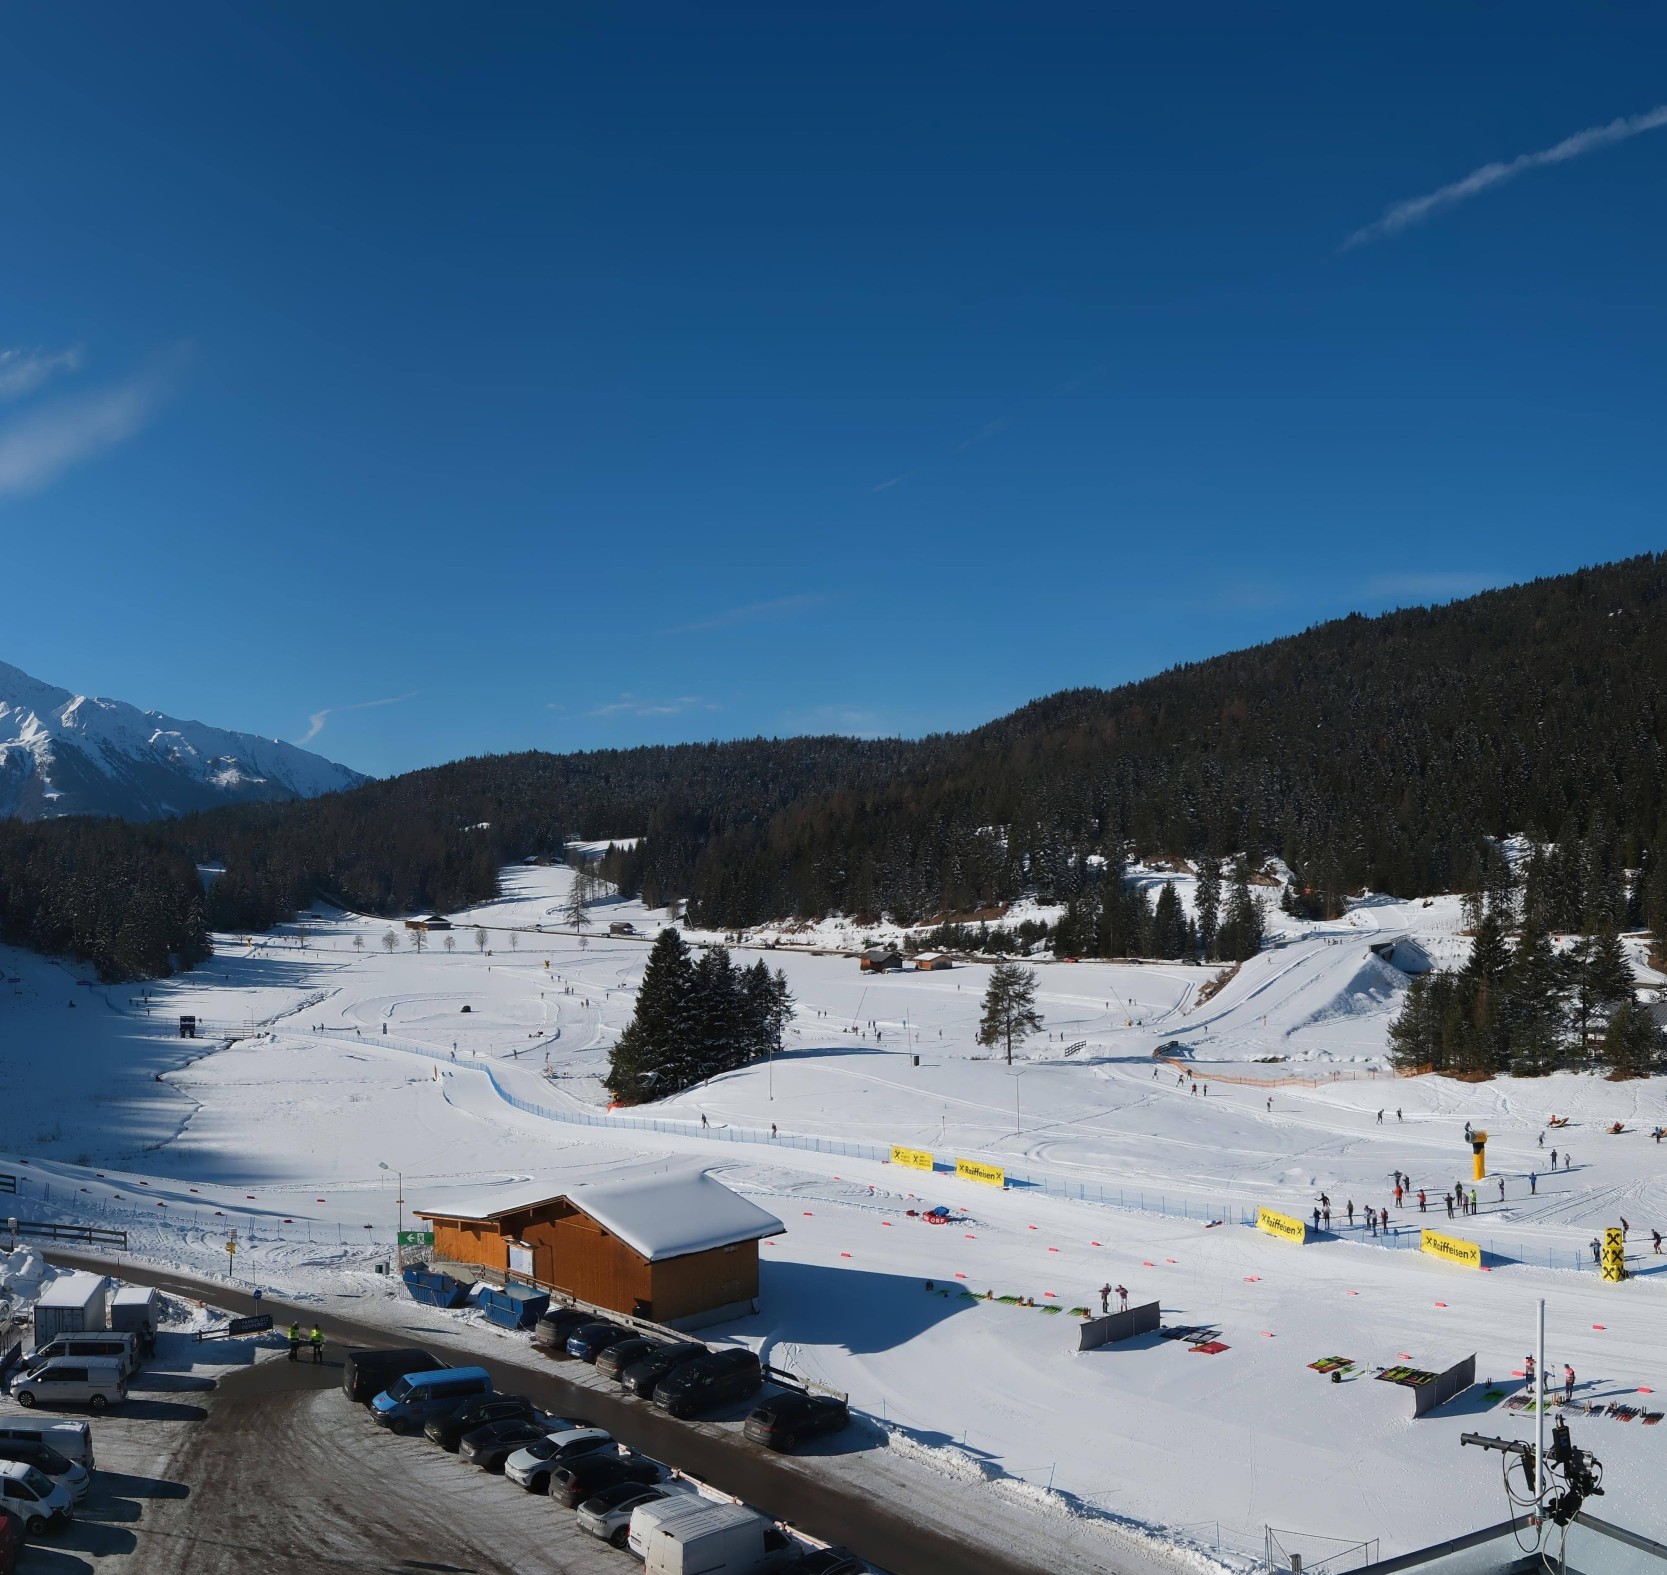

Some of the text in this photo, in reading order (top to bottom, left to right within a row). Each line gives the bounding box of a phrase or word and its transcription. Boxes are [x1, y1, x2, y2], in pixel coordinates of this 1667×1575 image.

[965, 1165, 995, 1180] Raiffeisen
[1267, 1216, 1295, 1235] Raiffeisen
[1433, 1239, 1470, 1259] Raiffeisen
